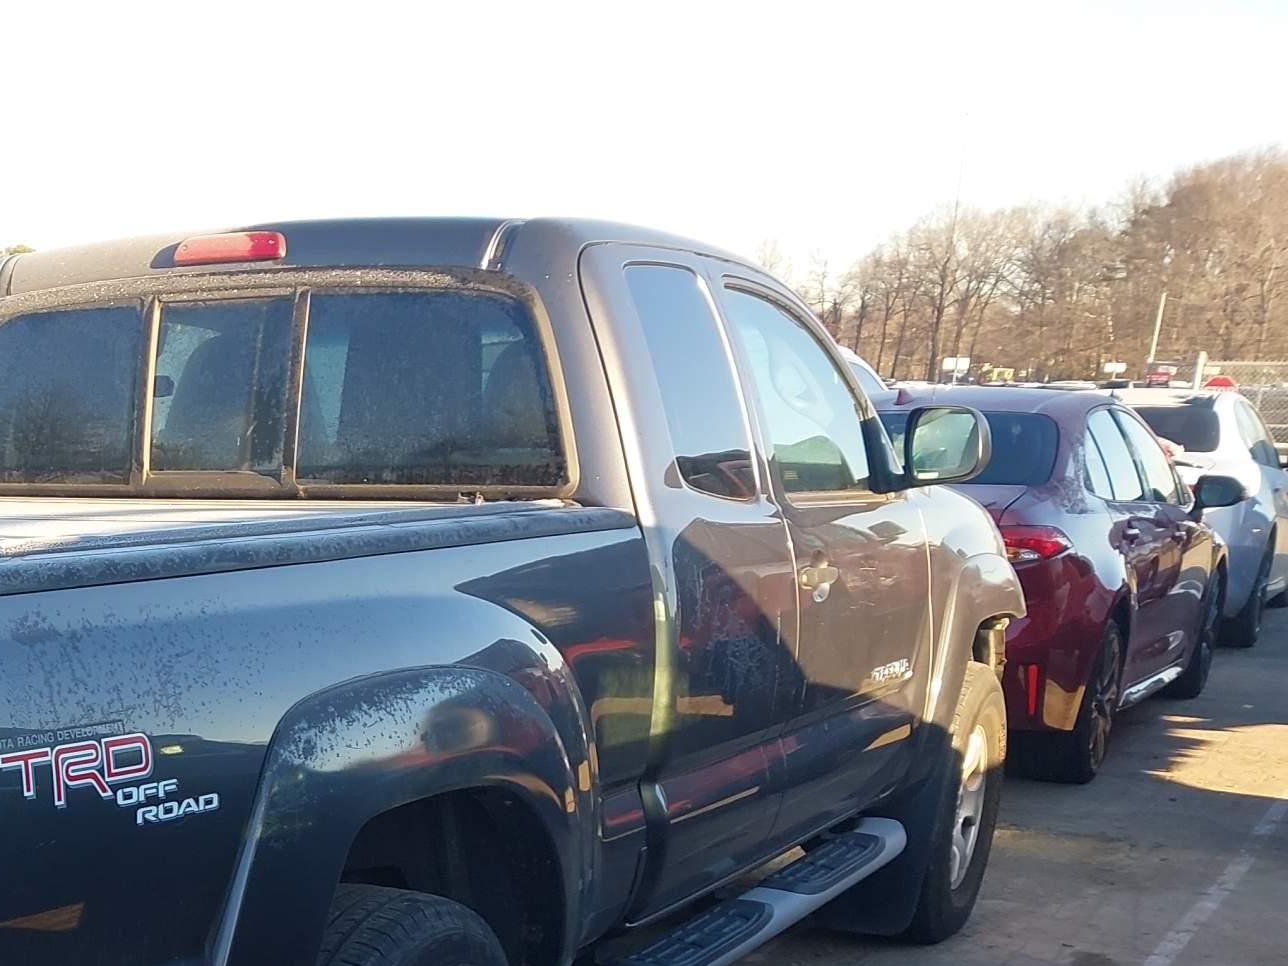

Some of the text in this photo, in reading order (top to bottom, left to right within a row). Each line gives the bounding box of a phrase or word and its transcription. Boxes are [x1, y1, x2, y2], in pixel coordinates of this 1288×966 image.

[17, 731, 56, 748] RACING
[116, 778, 179, 808] OFF
[136, 793, 220, 827] ROAD
